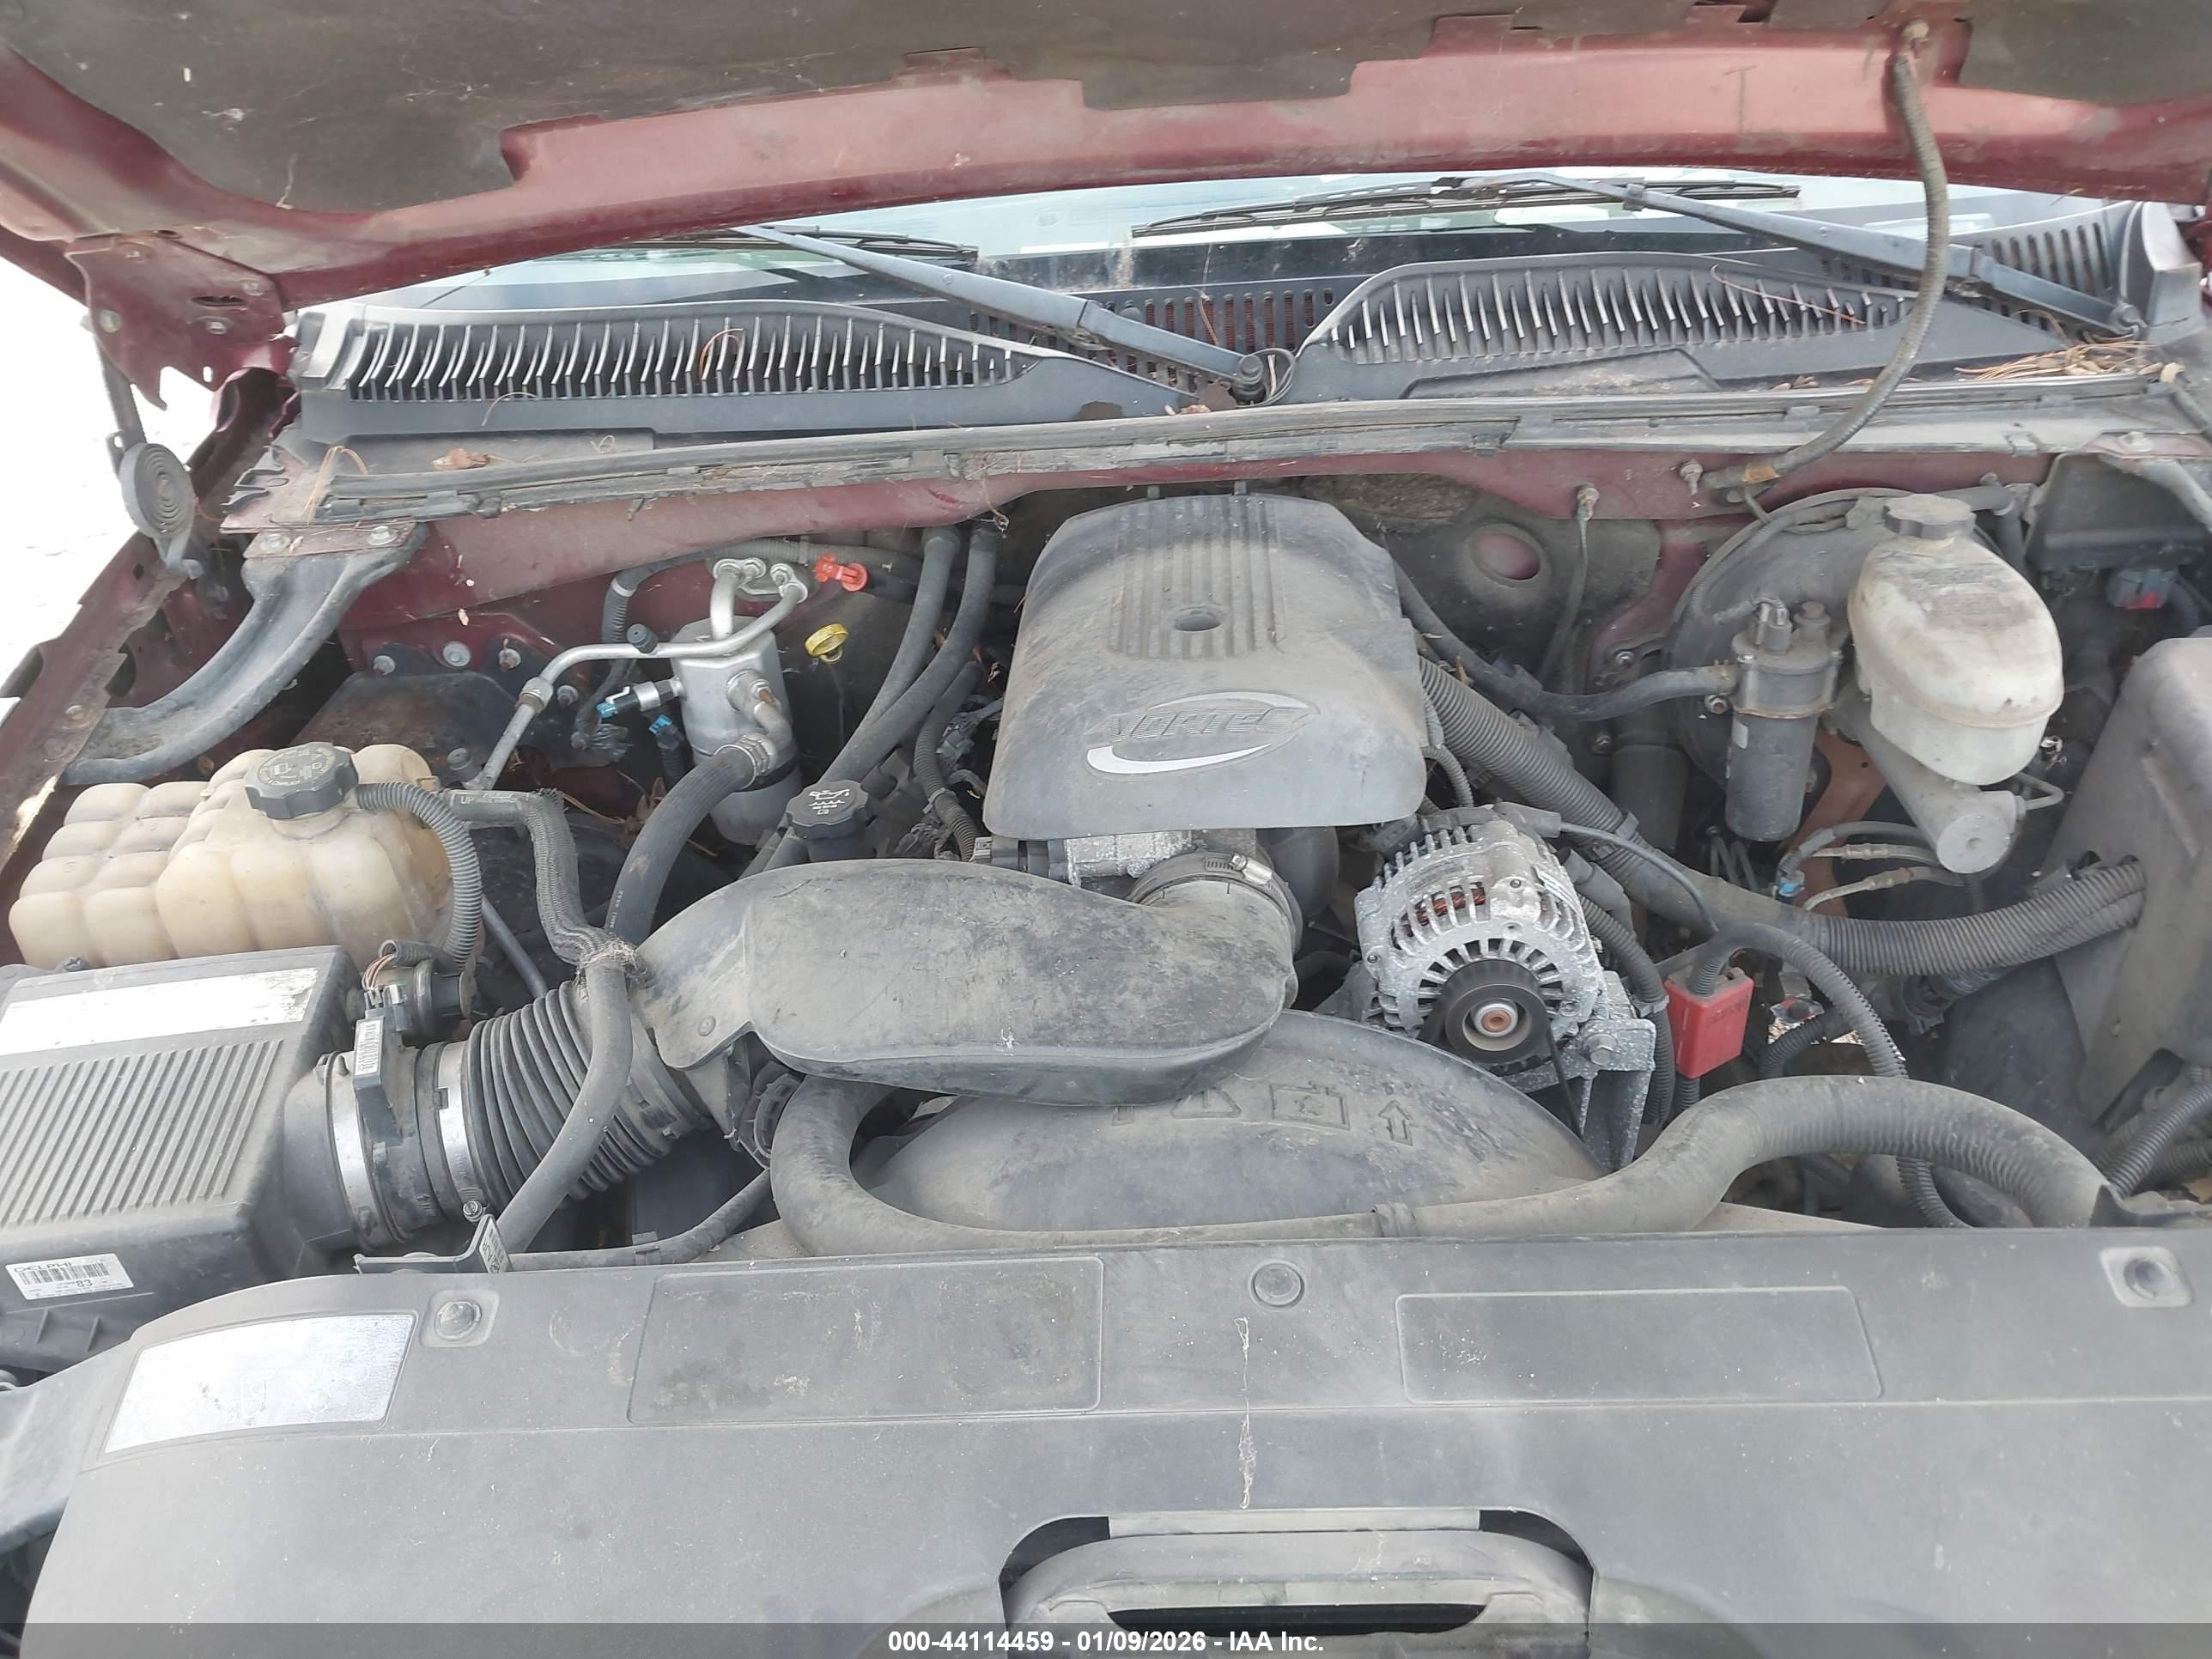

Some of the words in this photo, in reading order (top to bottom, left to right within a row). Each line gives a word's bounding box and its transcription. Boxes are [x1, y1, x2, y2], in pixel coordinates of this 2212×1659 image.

[1104, 707, 1295, 742] VORTEC
[460, 796, 475, 805] UP
[13, 1261, 72, 1273] DELPHI
[76, 1279, 93, 1287] 83
